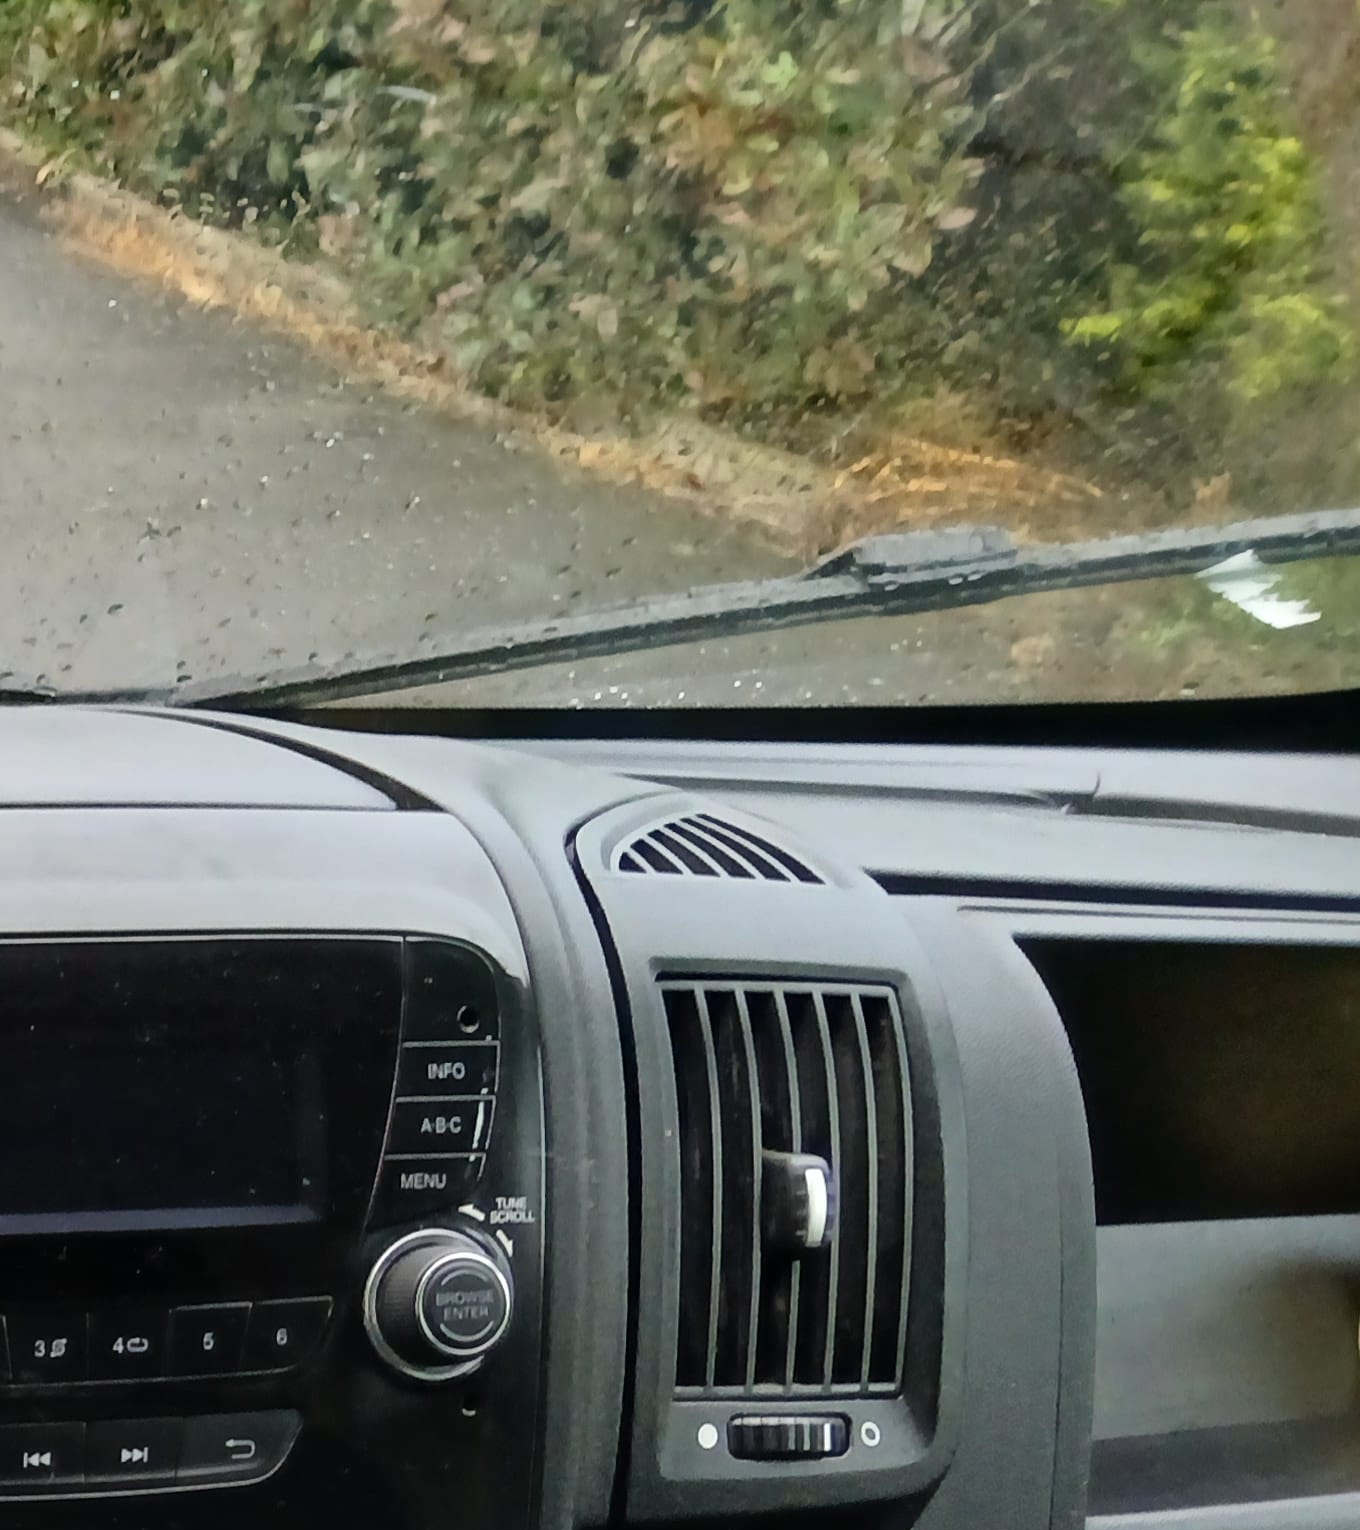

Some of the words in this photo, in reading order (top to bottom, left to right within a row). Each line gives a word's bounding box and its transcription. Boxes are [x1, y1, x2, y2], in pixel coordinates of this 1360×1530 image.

[427, 1061, 466, 1080] INFO
[400, 1172, 447, 1190] MENU
[112, 1336, 125, 1354] 4
[202, 1332, 215, 1351] 5
[276, 1327, 288, 1346] 6
[34, 1339, 46, 1358] 3
